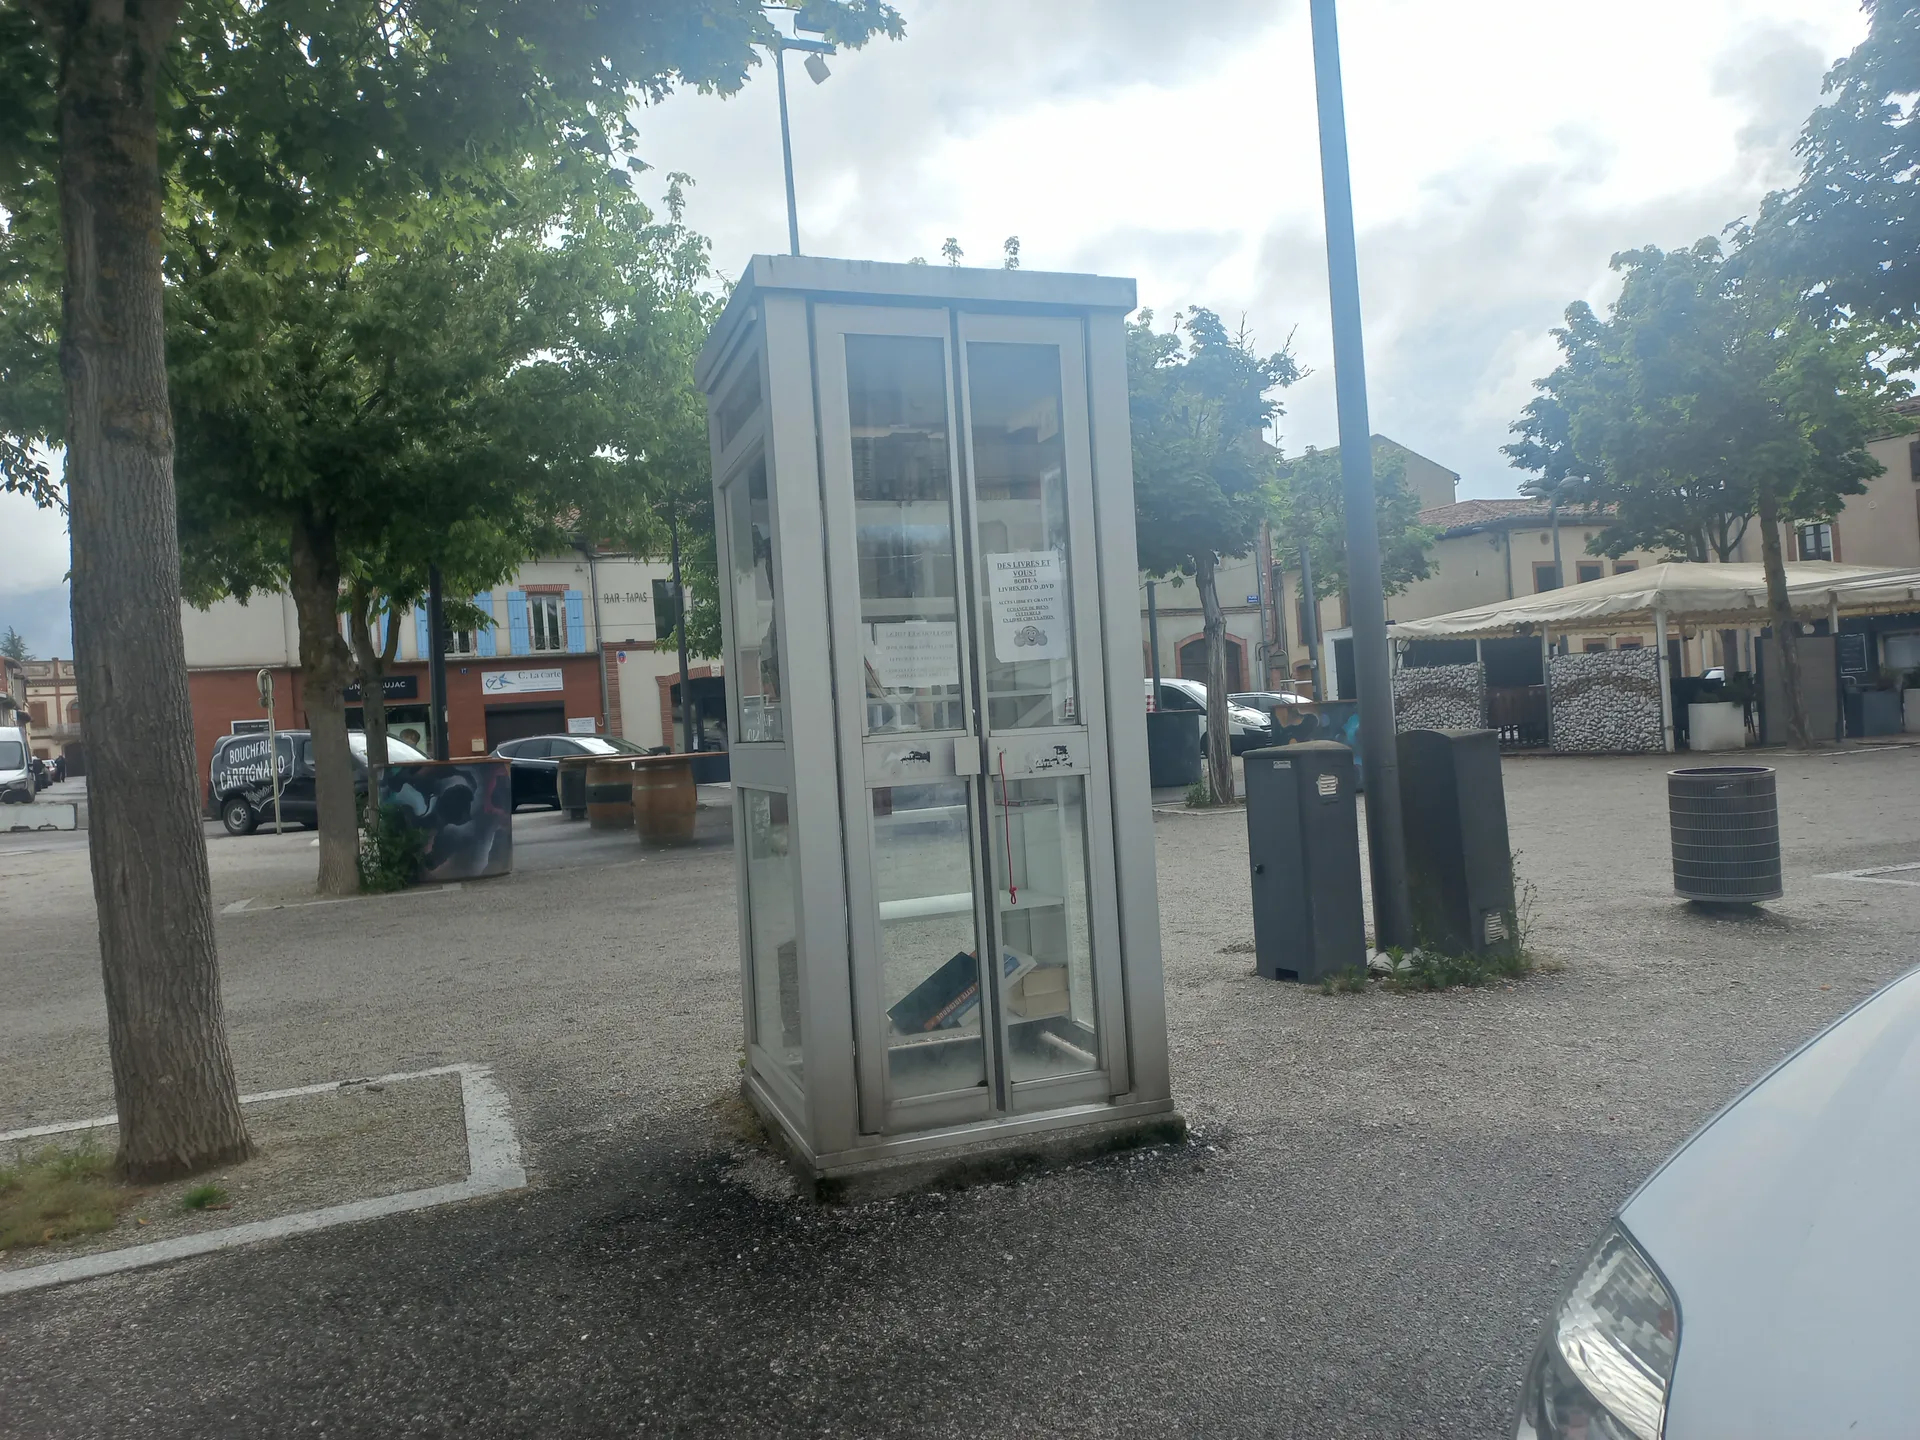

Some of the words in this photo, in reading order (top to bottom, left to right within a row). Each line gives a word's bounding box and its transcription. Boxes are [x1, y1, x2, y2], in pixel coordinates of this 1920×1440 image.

[1013, 560, 1040, 568] LIVRES
[604, 592, 620, 604] BAR
[625, 591, 648, 604] TAPAS
[229, 739, 273, 765] BOUCHERIE
